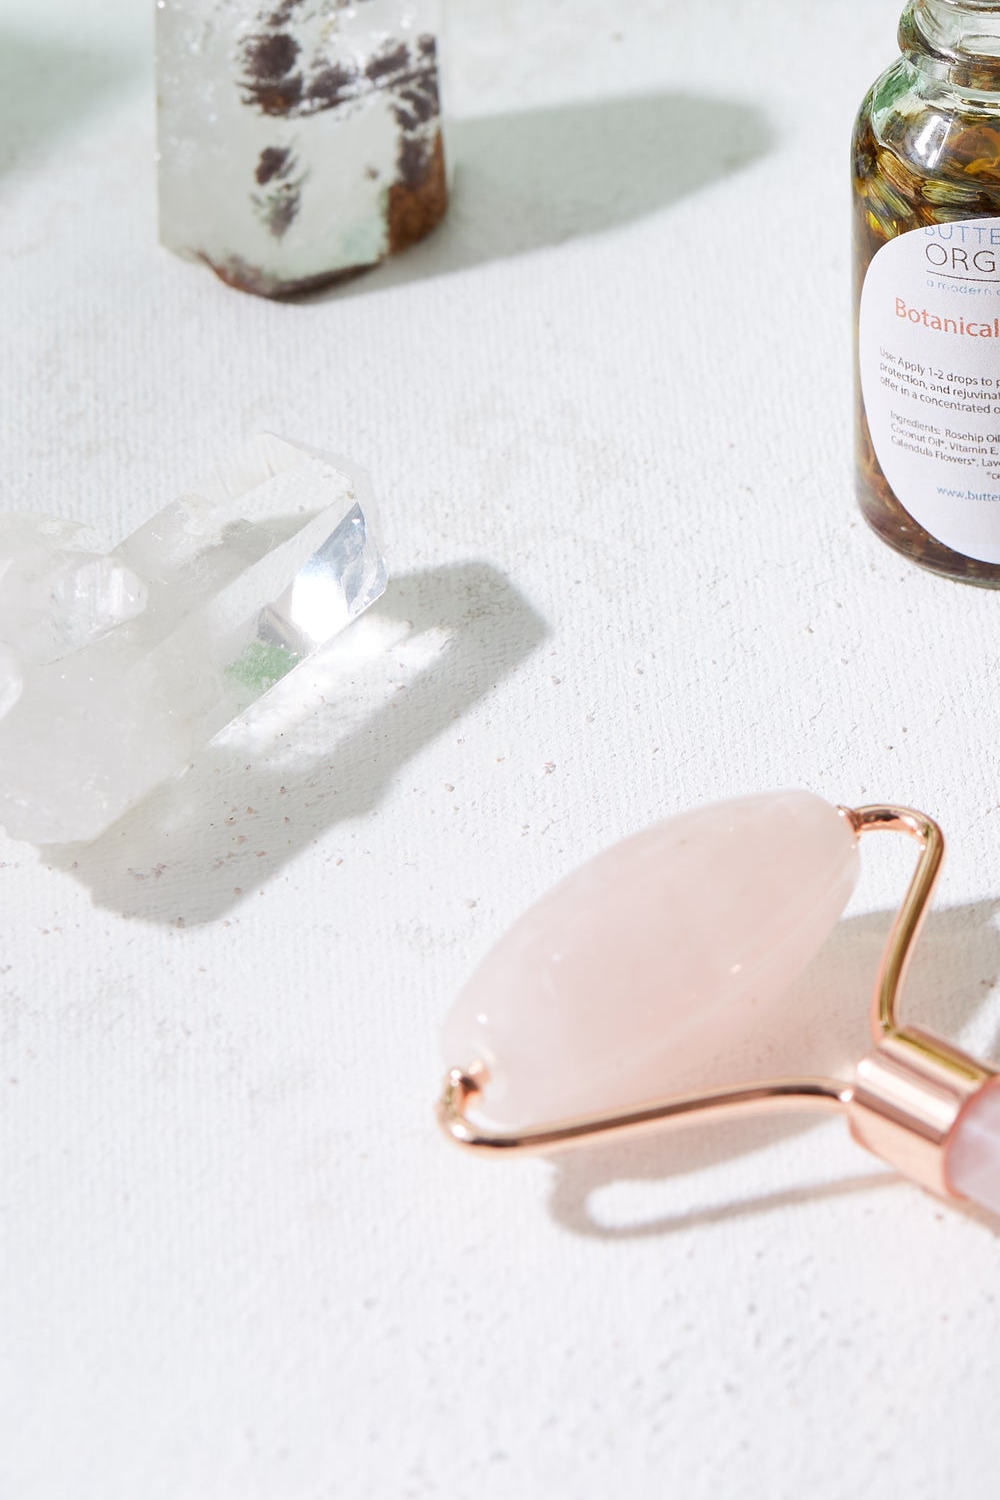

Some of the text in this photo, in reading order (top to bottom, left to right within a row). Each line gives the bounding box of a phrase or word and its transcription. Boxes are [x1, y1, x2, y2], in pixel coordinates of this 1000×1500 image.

[937, 282, 993, 296] modern
[895, 297, 1000, 338] Botanical
[880, 362, 928, 390] protection,
[929, 382, 950, 395] and
[897, 357, 925, 376] Apply
[928, 367, 944, 380] 1-2
[946, 372, 978, 387] drops
[981, 378, 993, 387] to
[880, 376, 898, 391] offer
[900, 388, 910, 397] in
[911, 391, 918, 400] a
[919, 393, 991, 414] concentrated
[890, 411, 941, 436] Ingredients:
[945, 428, 984, 444] Rosehip
[891, 423, 926, 443] Coconut
[949, 442, 988, 455] Vitamin
[990, 446, 999, 456] E,
[891, 435, 933, 458] Calendula
